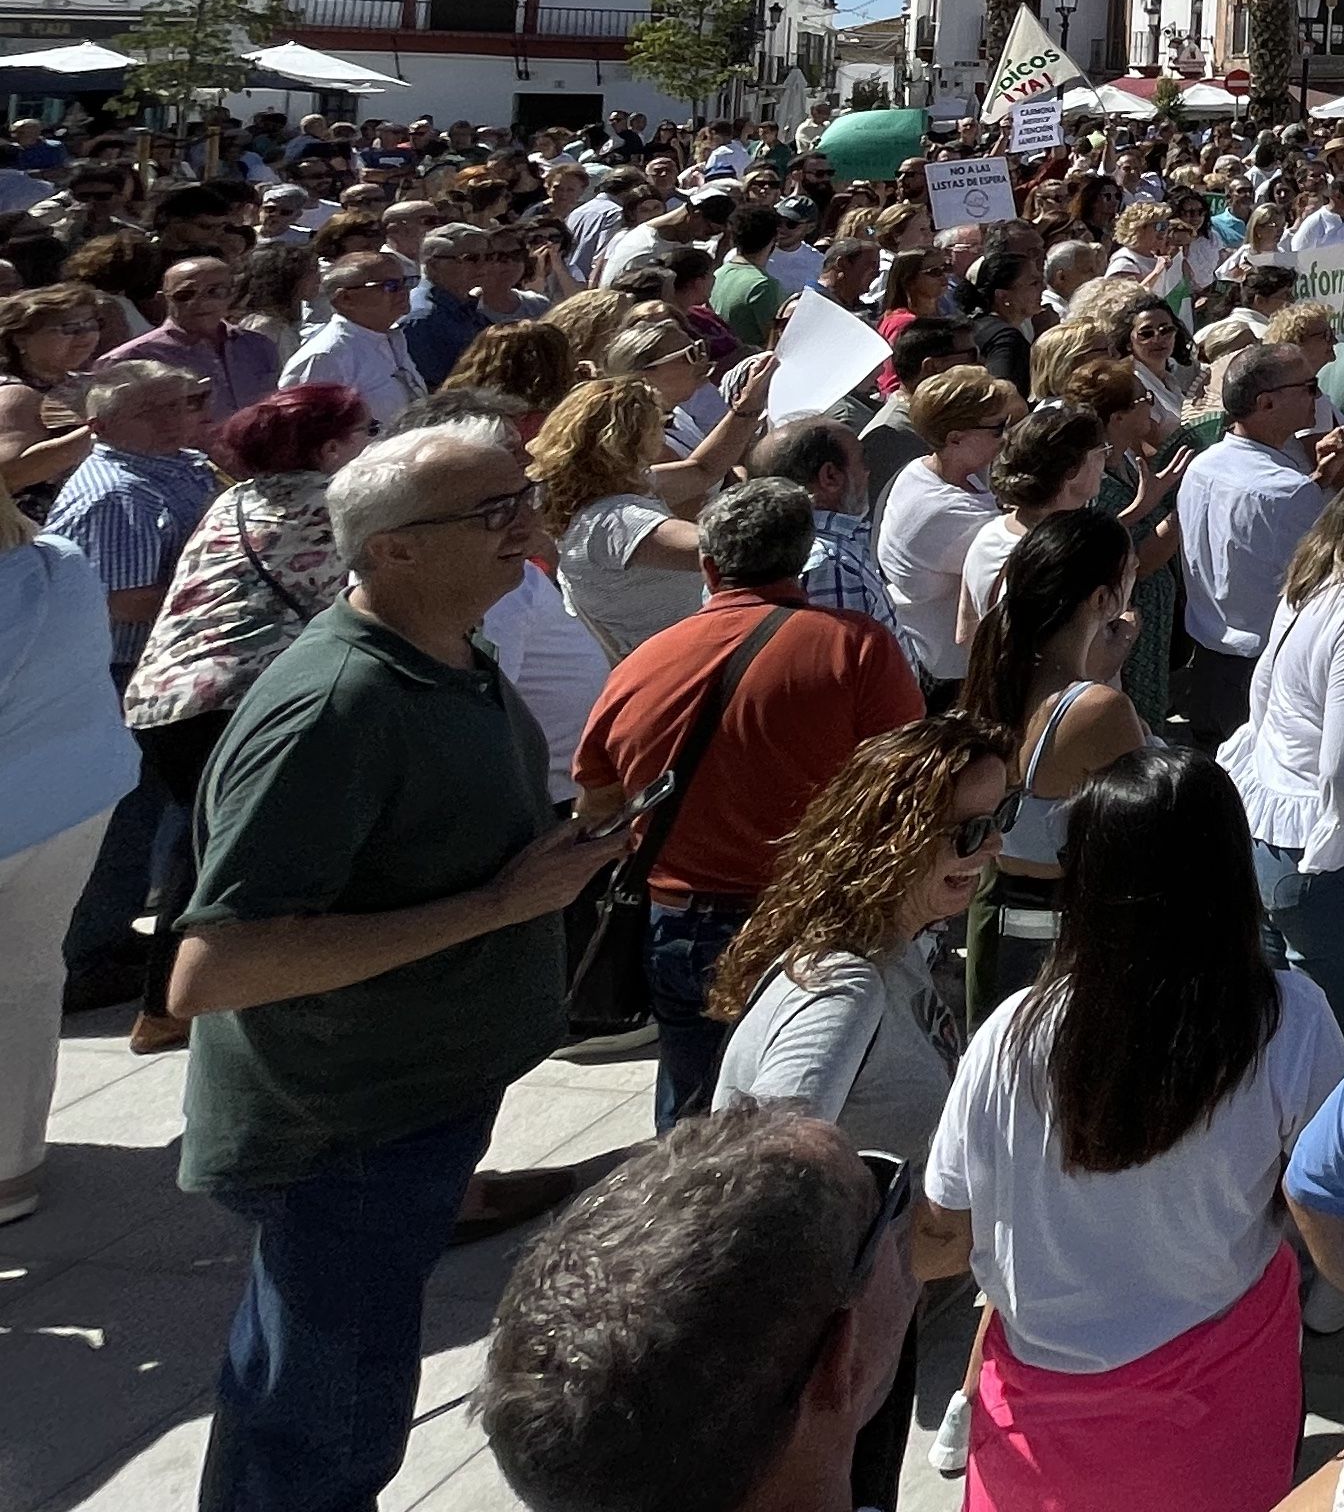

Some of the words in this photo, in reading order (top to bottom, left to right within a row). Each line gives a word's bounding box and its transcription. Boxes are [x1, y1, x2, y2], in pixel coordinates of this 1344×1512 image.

[949, 165, 965, 176] NO
[966, 165, 974, 174] A
[974, 163, 990, 173] LAS
[932, 178, 965, 191] LISTAS
[966, 177, 978, 188] DE
[978, 174, 1007, 186] ESPERA
